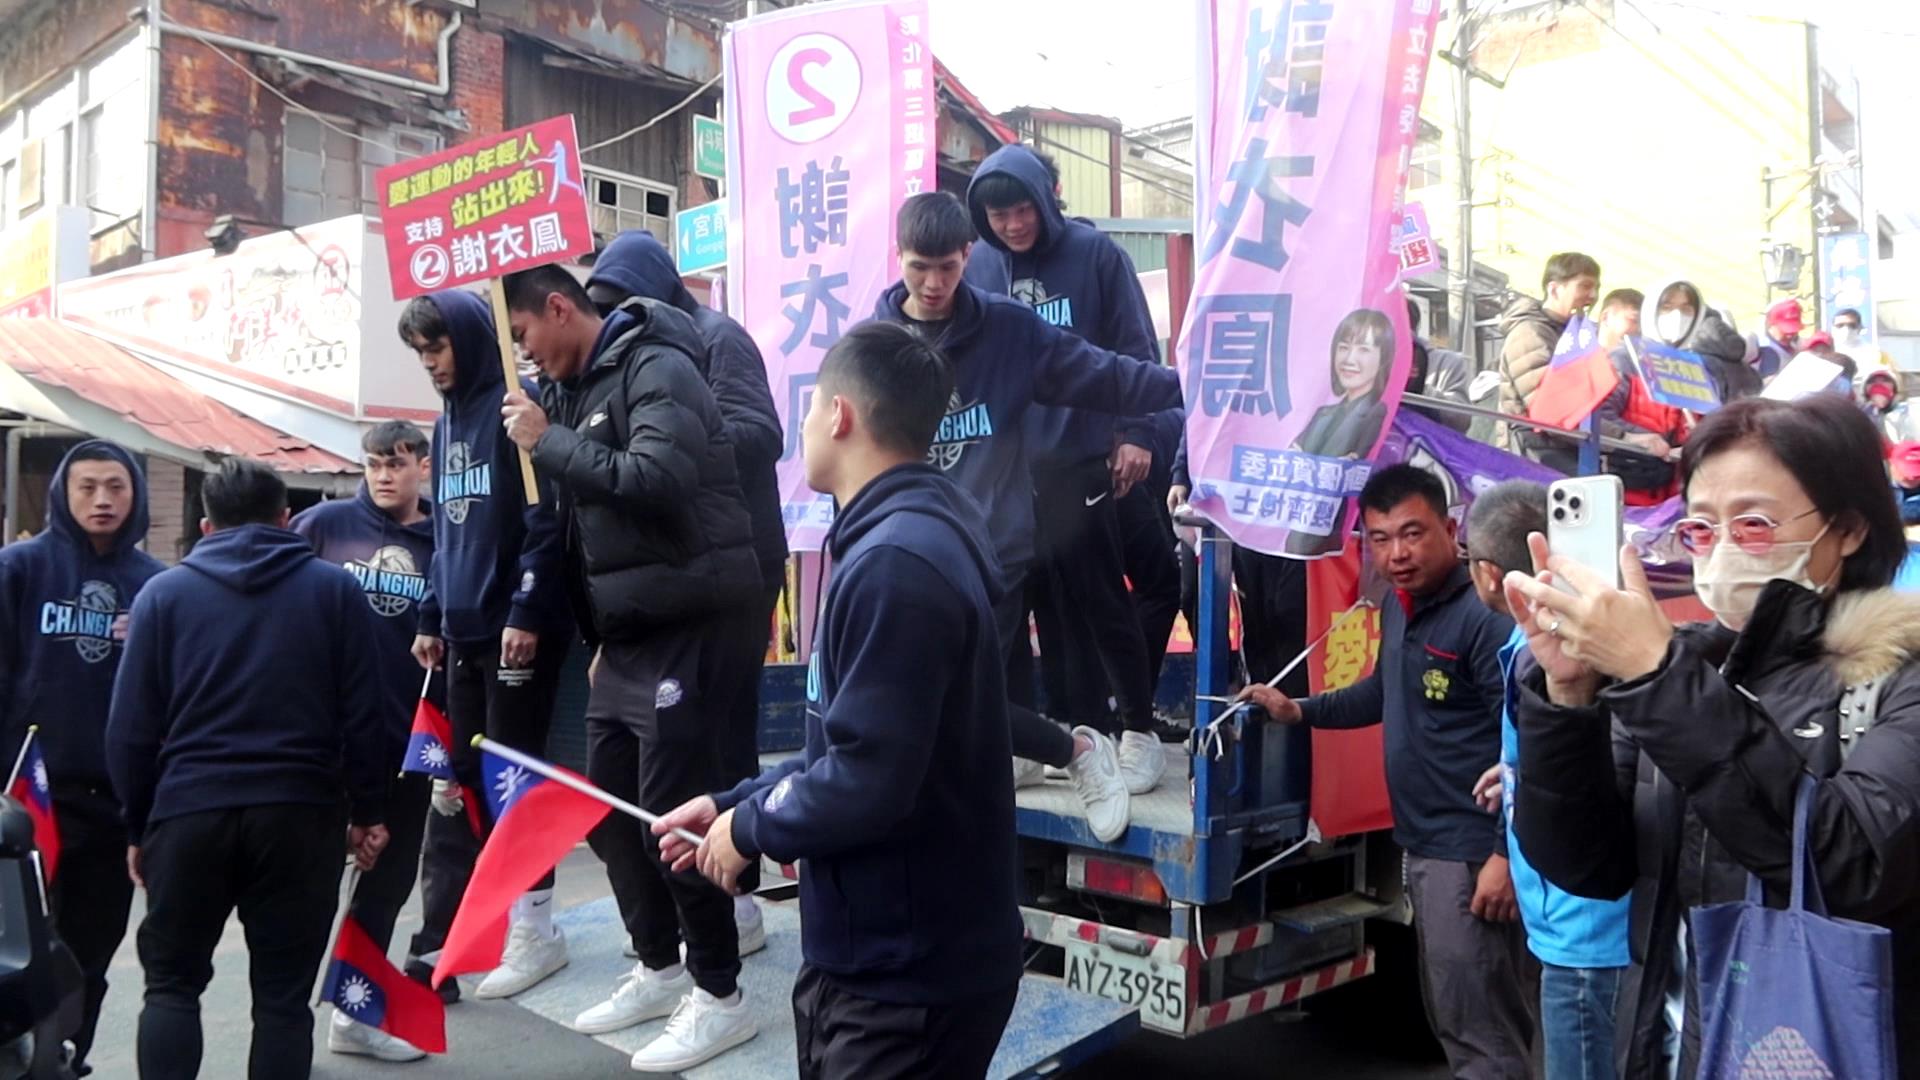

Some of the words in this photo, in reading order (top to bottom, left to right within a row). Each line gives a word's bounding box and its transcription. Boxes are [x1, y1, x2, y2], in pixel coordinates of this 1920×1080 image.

[388, 131, 540, 208] 愛運動的年輕人
[405, 216, 444, 245] 支持
[450, 212, 568, 277] 謝衣鳳
[1321, 607, 1381, 693] 愛
